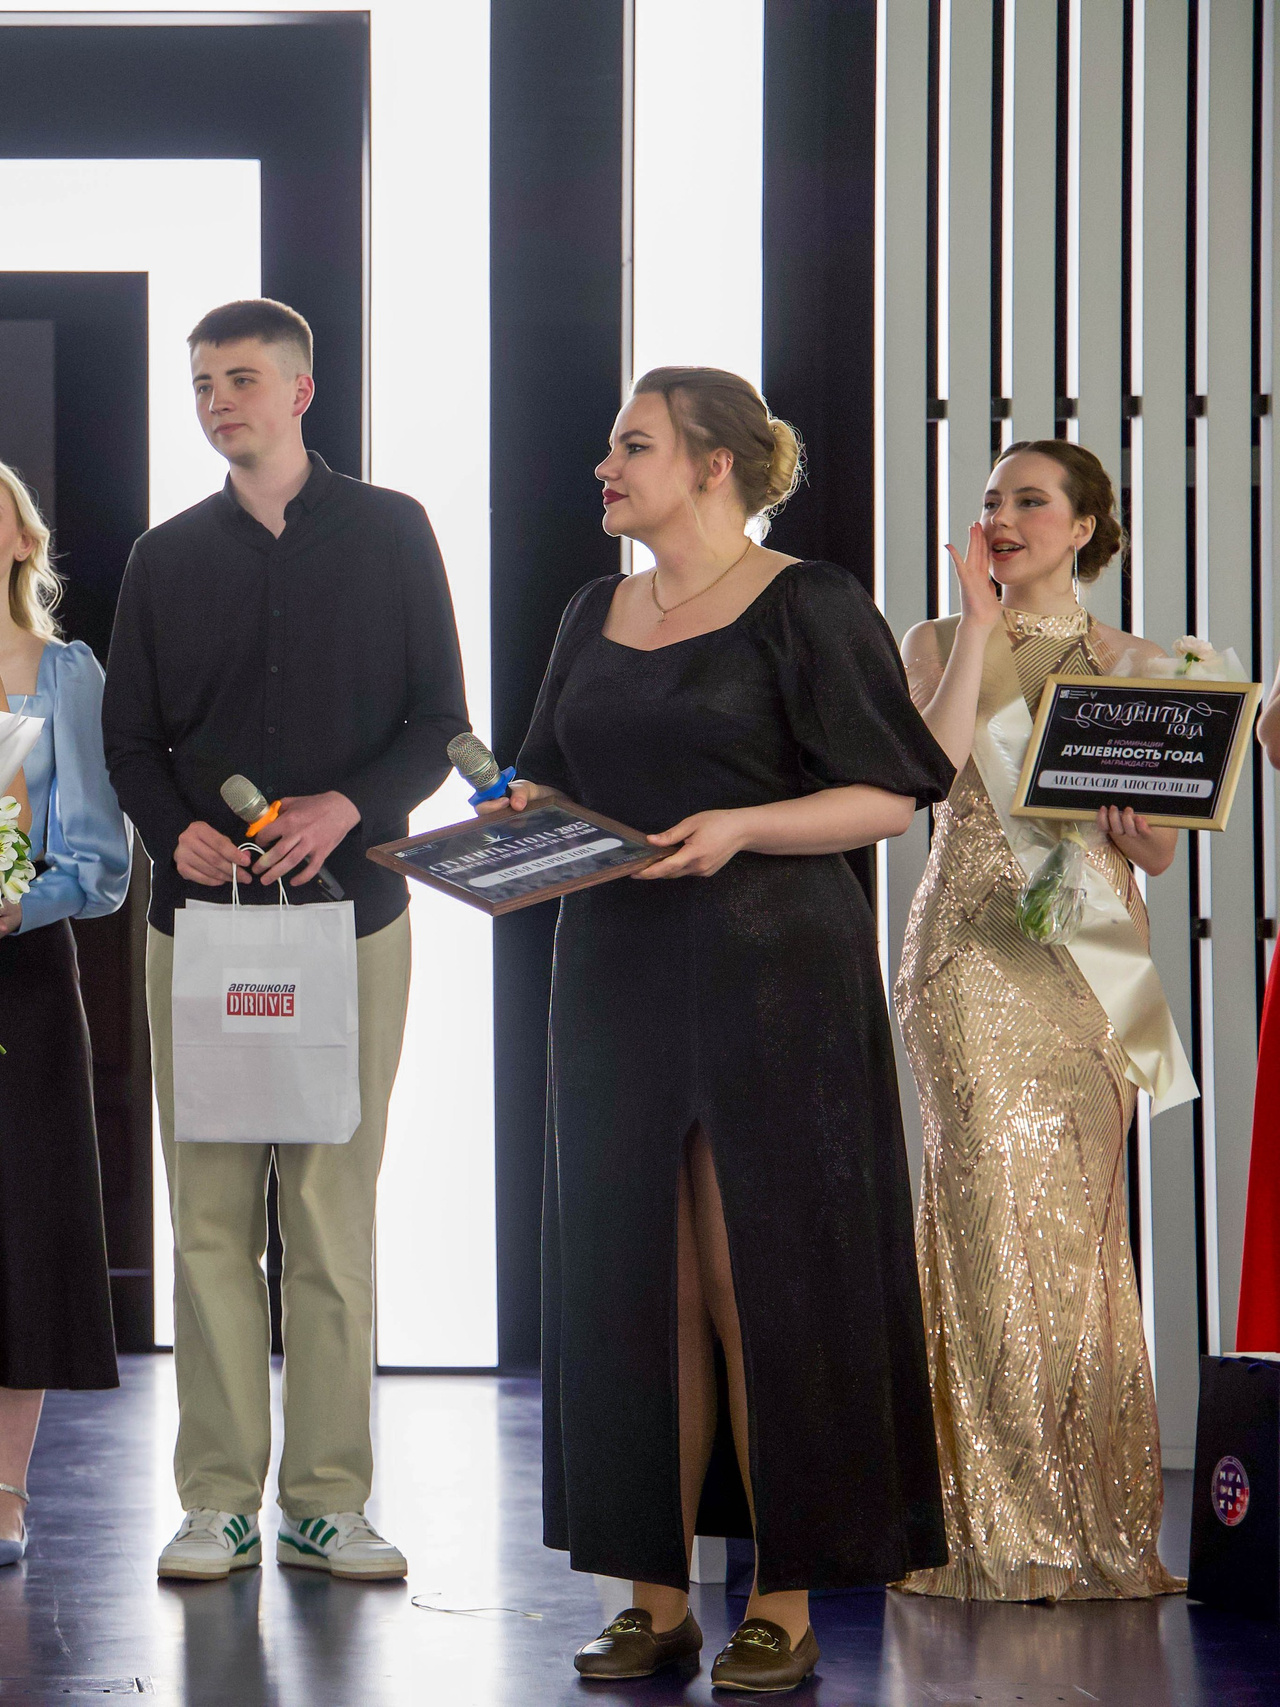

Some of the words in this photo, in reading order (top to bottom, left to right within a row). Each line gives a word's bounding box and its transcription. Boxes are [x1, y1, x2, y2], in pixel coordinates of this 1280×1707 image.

[1077, 701, 1190, 726] СТУДЕНТЫ
[1166, 723, 1204, 739] ГОДА
[1061, 745, 1161, 760] ДУШЕВНОСТЬ
[1164, 750, 1204, 763] ГОДА
[1101, 759, 1159, 768] НАГРАЖДАЕТСЯ
[1051, 774, 1119, 788] АНАСТАСИЯ
[1121, 779, 1200, 794] АПОСТОЛИДИ
[554, 821, 590, 835] 2025
[228, 983, 296, 993] автошкола
[228, 994, 294, 1015] DRIVE
